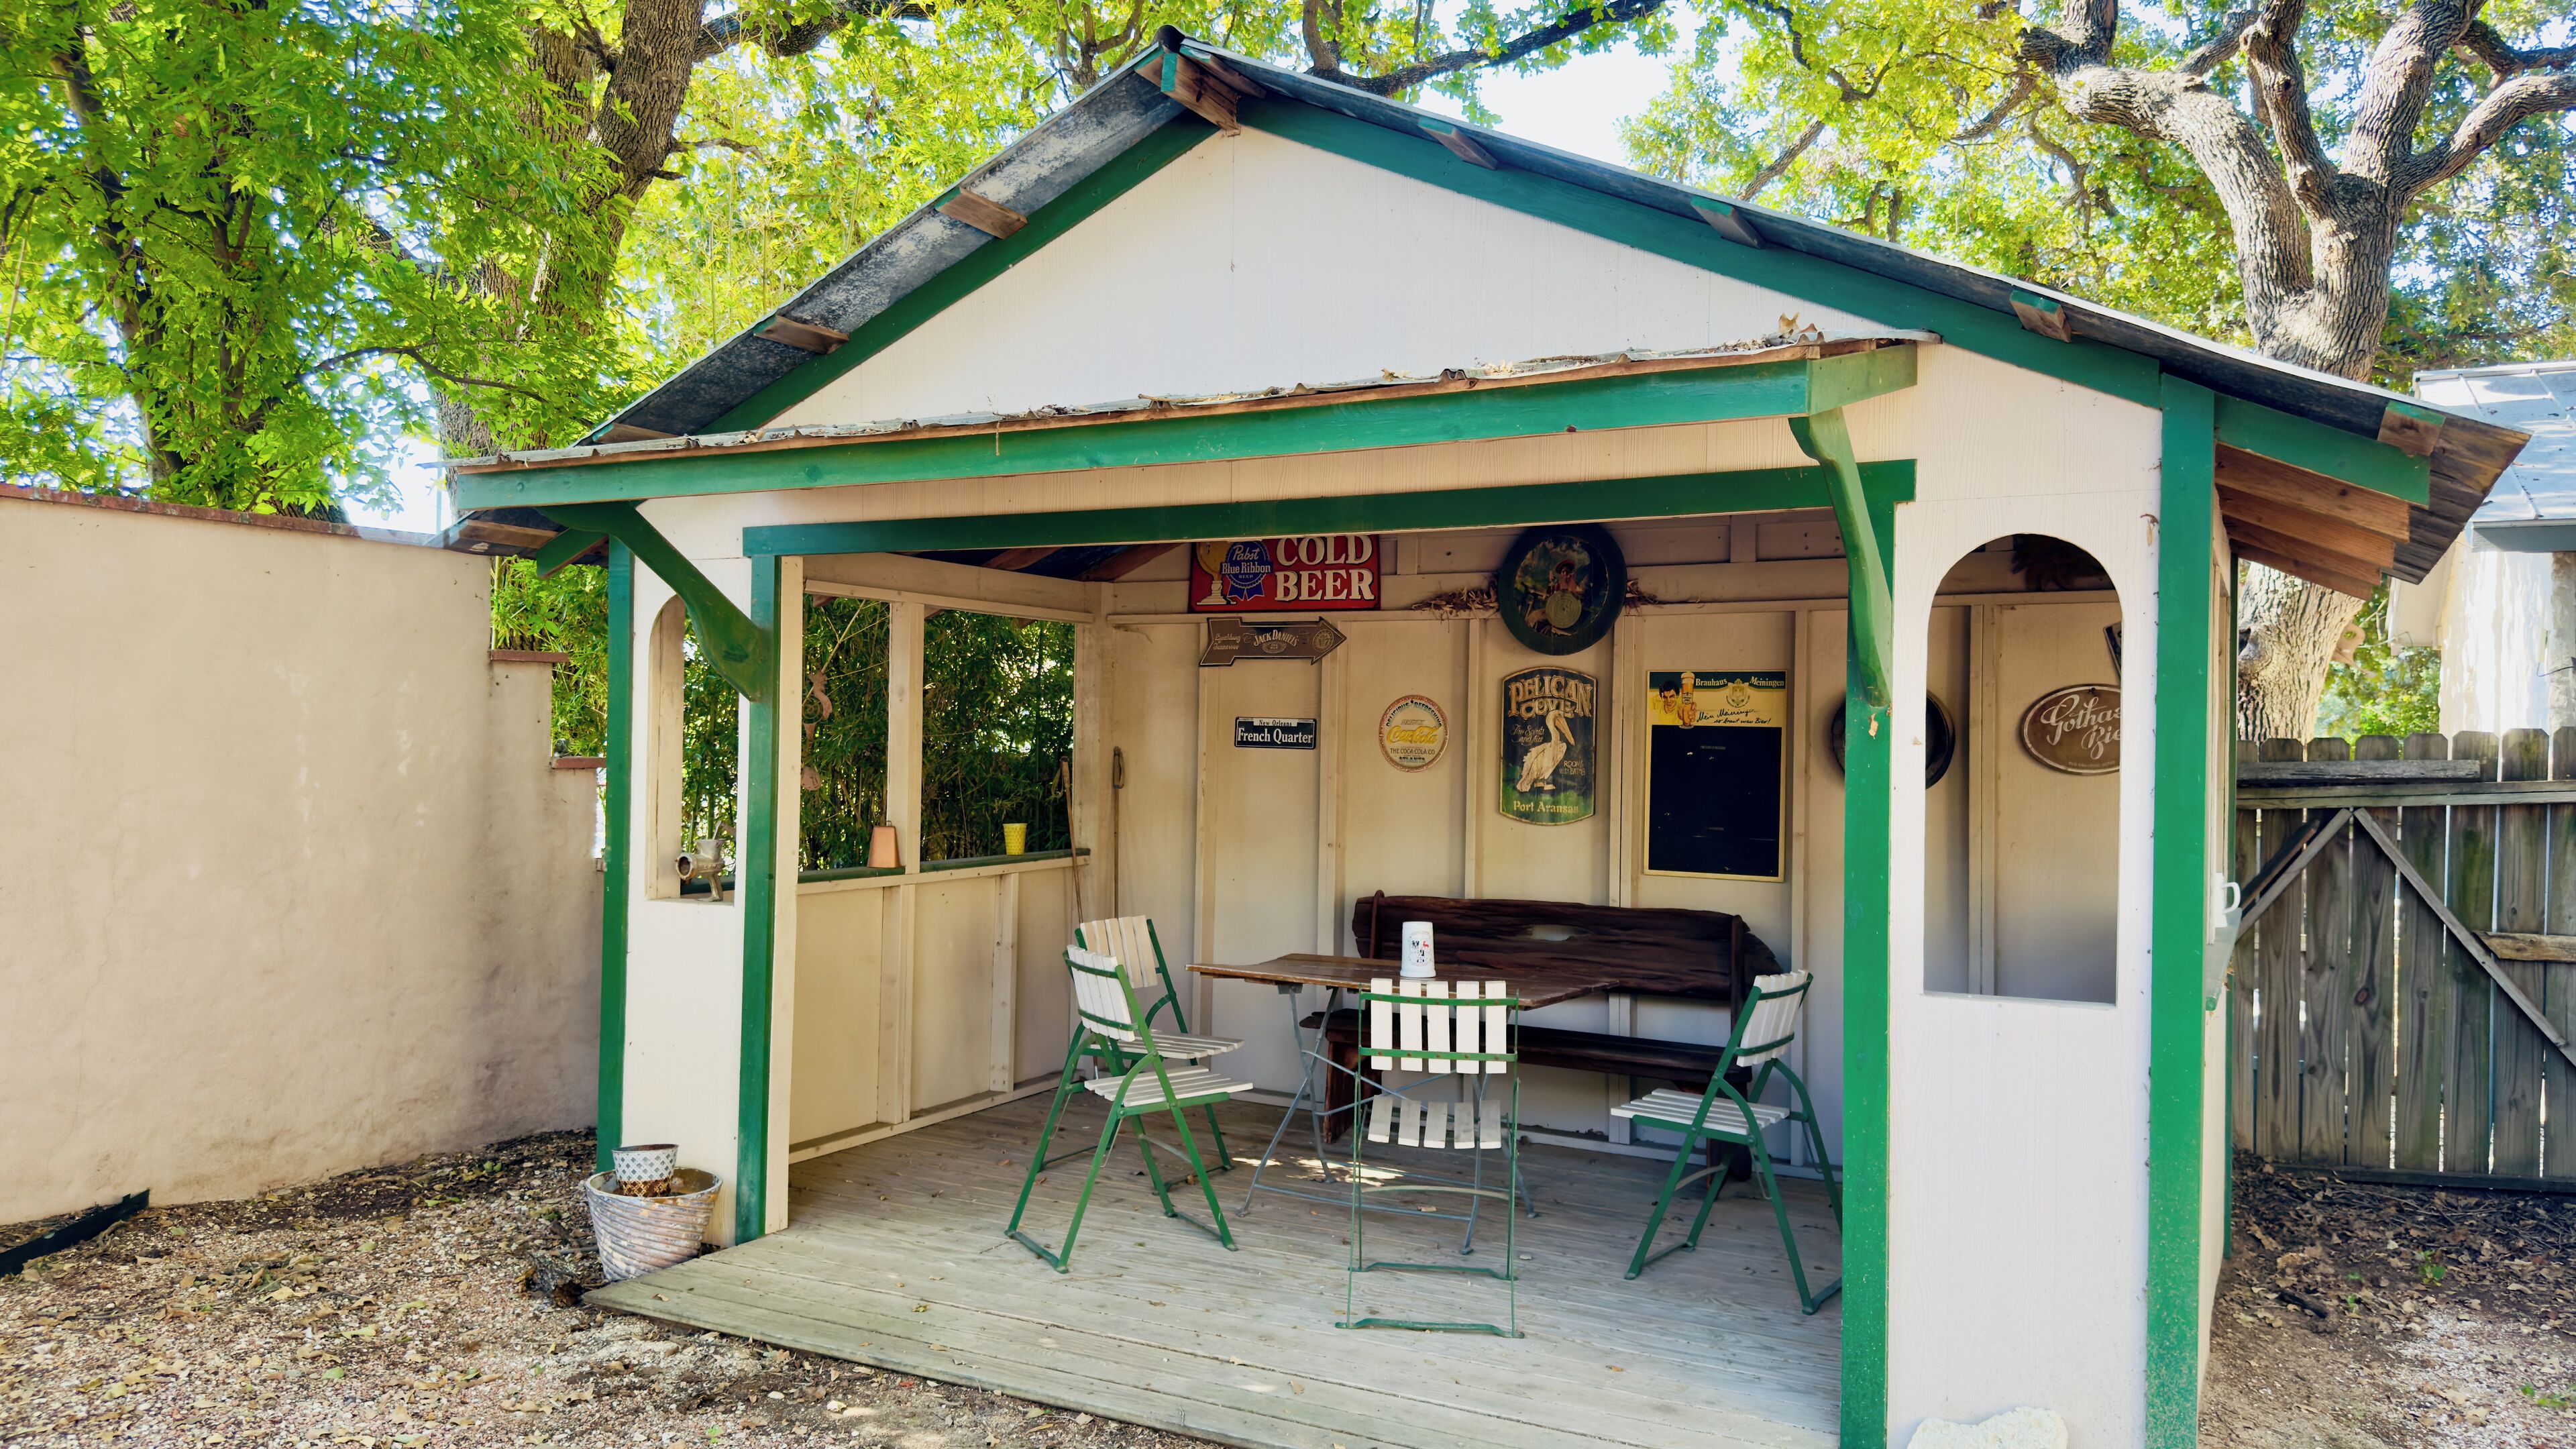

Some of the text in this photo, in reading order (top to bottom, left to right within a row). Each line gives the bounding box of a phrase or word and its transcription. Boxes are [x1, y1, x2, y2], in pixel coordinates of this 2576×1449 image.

[1233, 545, 1260, 561] Pabst
[1277, 535, 1373, 566] COLD
[1222, 562, 1271, 574] Blue Ribbon
[1275, 569, 1375, 601] BEER
[1254, 632, 1271, 646] JACK
[1695, 676, 1784, 688] Brauhaus Meiningen
[1508, 675, 1593, 717] PELICAN
[1520, 698, 1576, 720] COVE
[1237, 727, 1313, 744] French Quarter
[2081, 724, 2121, 760] Bie
[1513, 800, 1535, 812] Port
